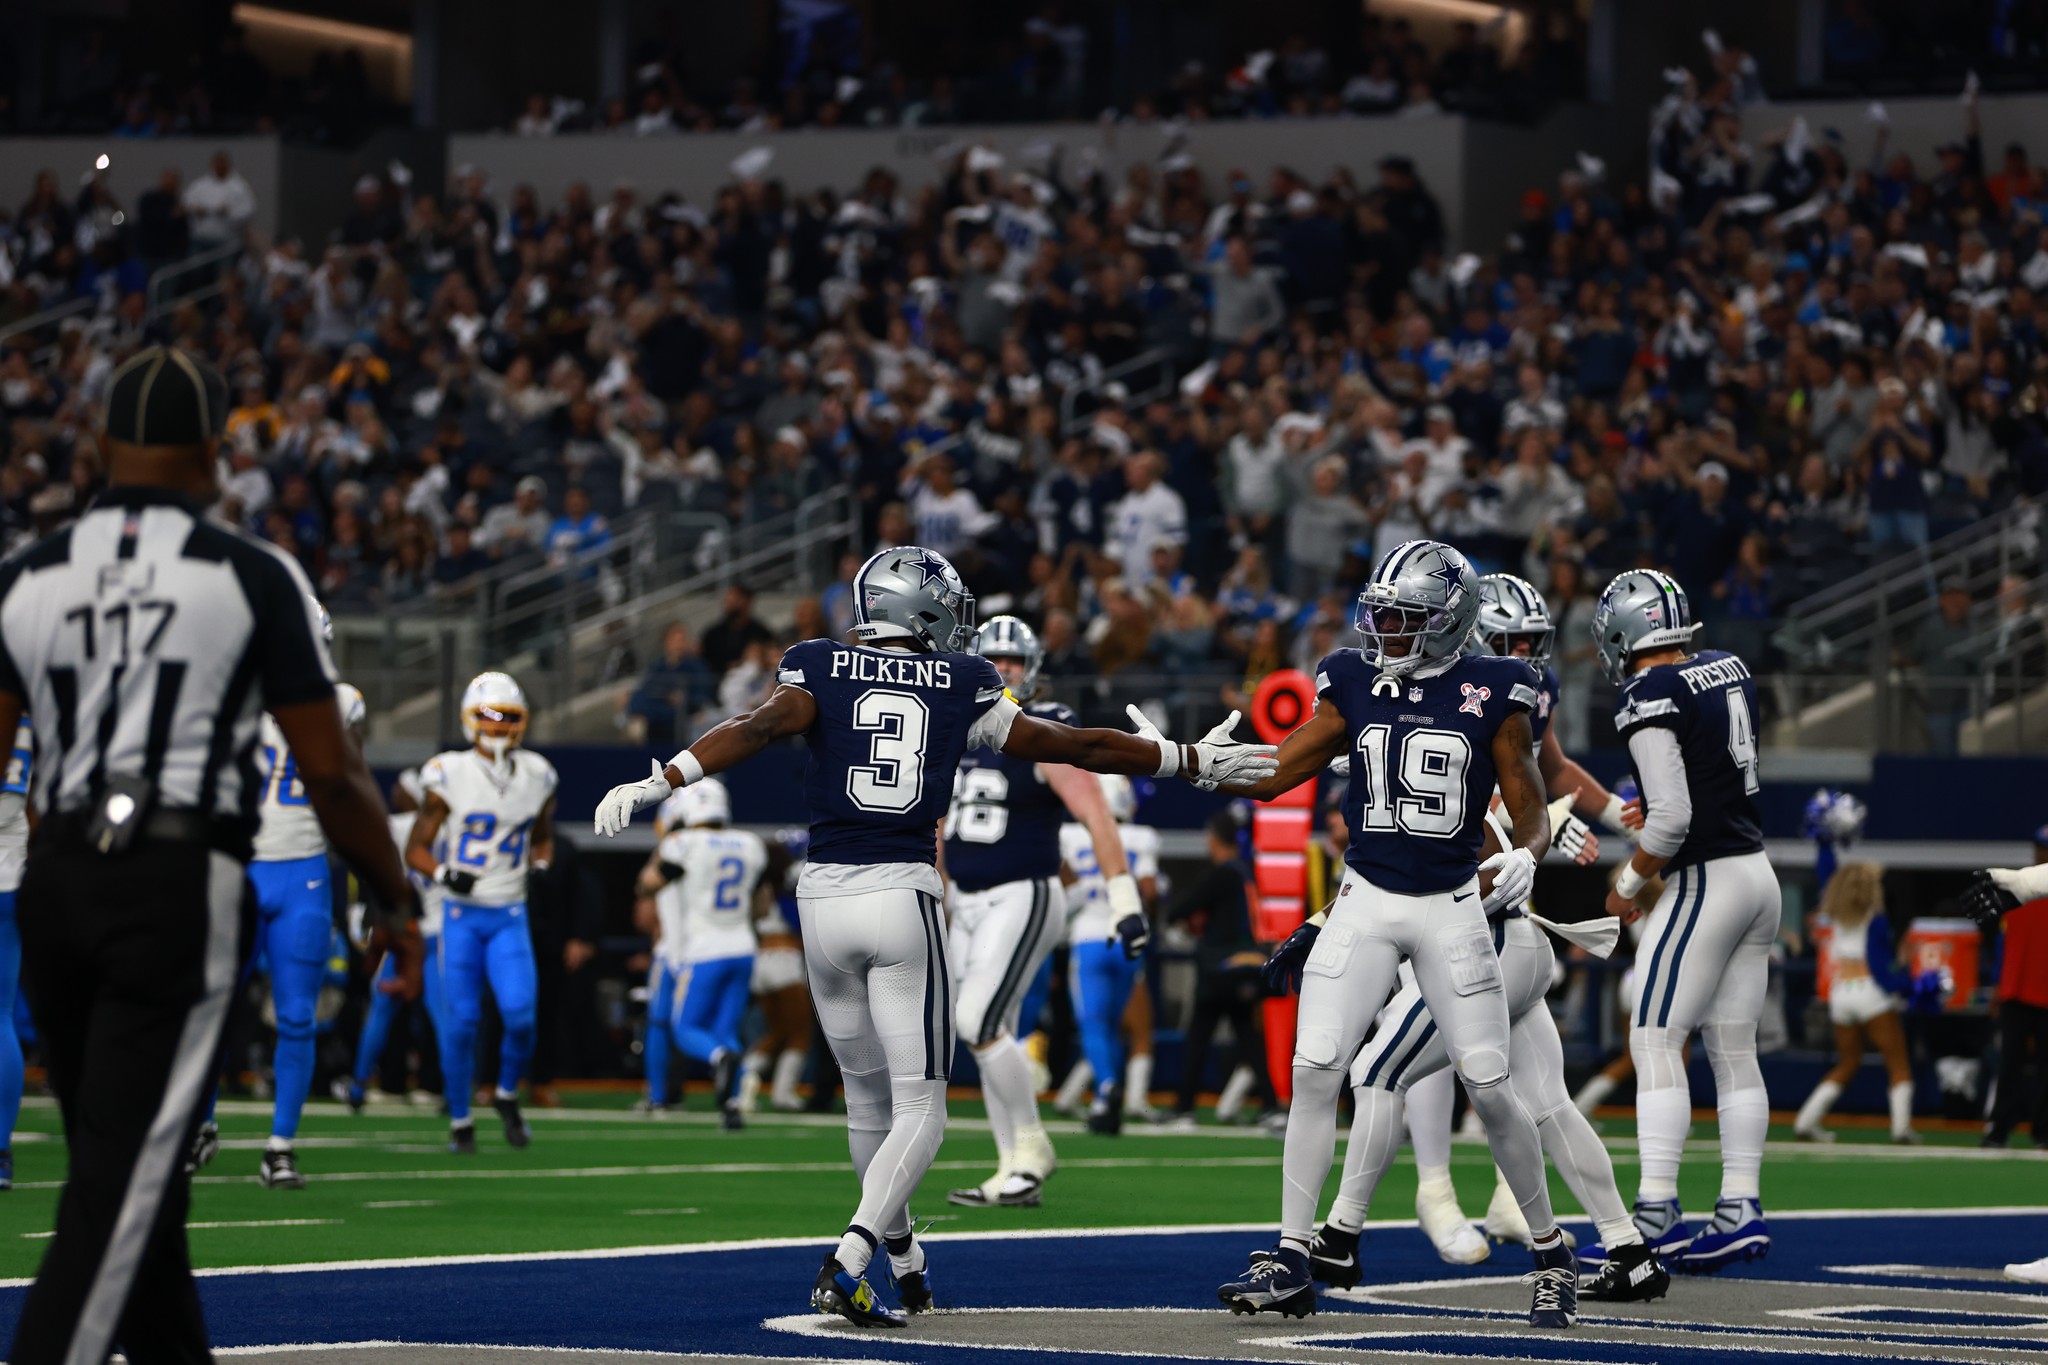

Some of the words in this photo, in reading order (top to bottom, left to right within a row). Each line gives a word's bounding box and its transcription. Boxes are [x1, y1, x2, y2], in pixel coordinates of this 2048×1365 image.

[97, 562, 156, 598] FJ
[65, 599, 177, 667] 117
[1653, 633, 1681, 643] CHOOSE
[831, 650, 951, 689] PICKENS
[1678, 655, 1751, 695] PRESCOTT
[1398, 714, 1434, 724] COWBOYS
[1726, 686, 1760, 796] 4
[846, 688, 930, 815] 3
[1357, 723, 1472, 839] 19
[457, 812, 536, 869] 24
[714, 856, 745, 911] 2
[1628, 1259, 1654, 1288] NIKE
